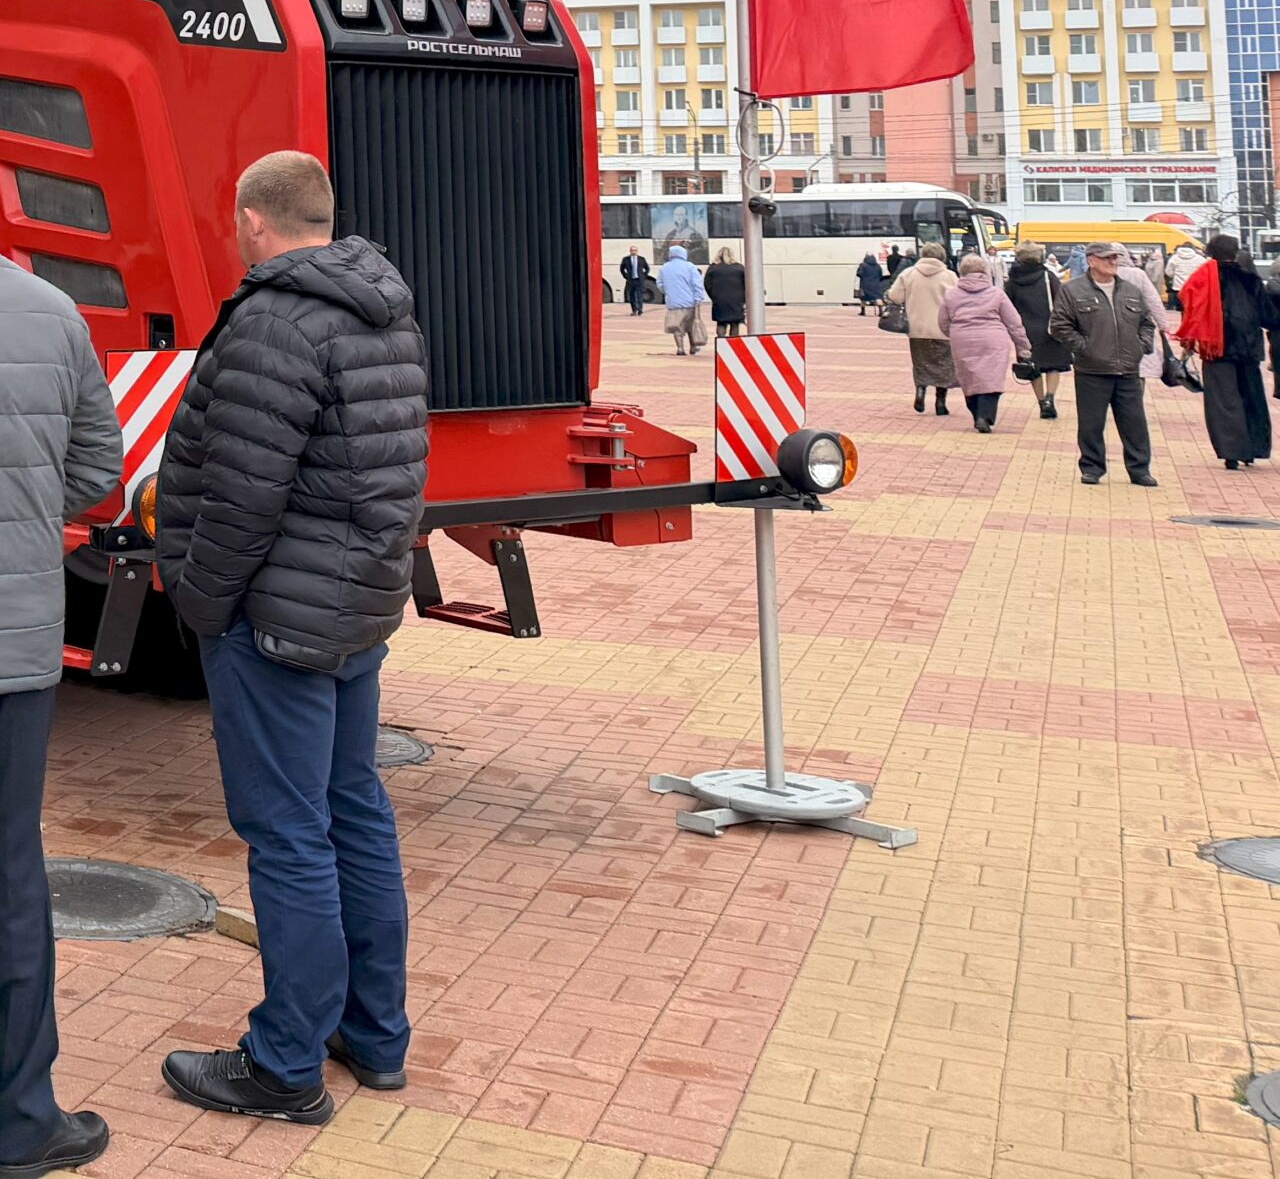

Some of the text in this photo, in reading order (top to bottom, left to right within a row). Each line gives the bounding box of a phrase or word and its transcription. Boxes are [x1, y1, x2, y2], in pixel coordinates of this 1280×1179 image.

[179, 9, 247, 42] 2400
[406, 39, 522, 58] РОСТСЕЛЬМАШ
[1035, 165, 1217, 175] КАПИТАЛ МЕДИЦИНСКОЕ СТРАХОВАНИЕ
